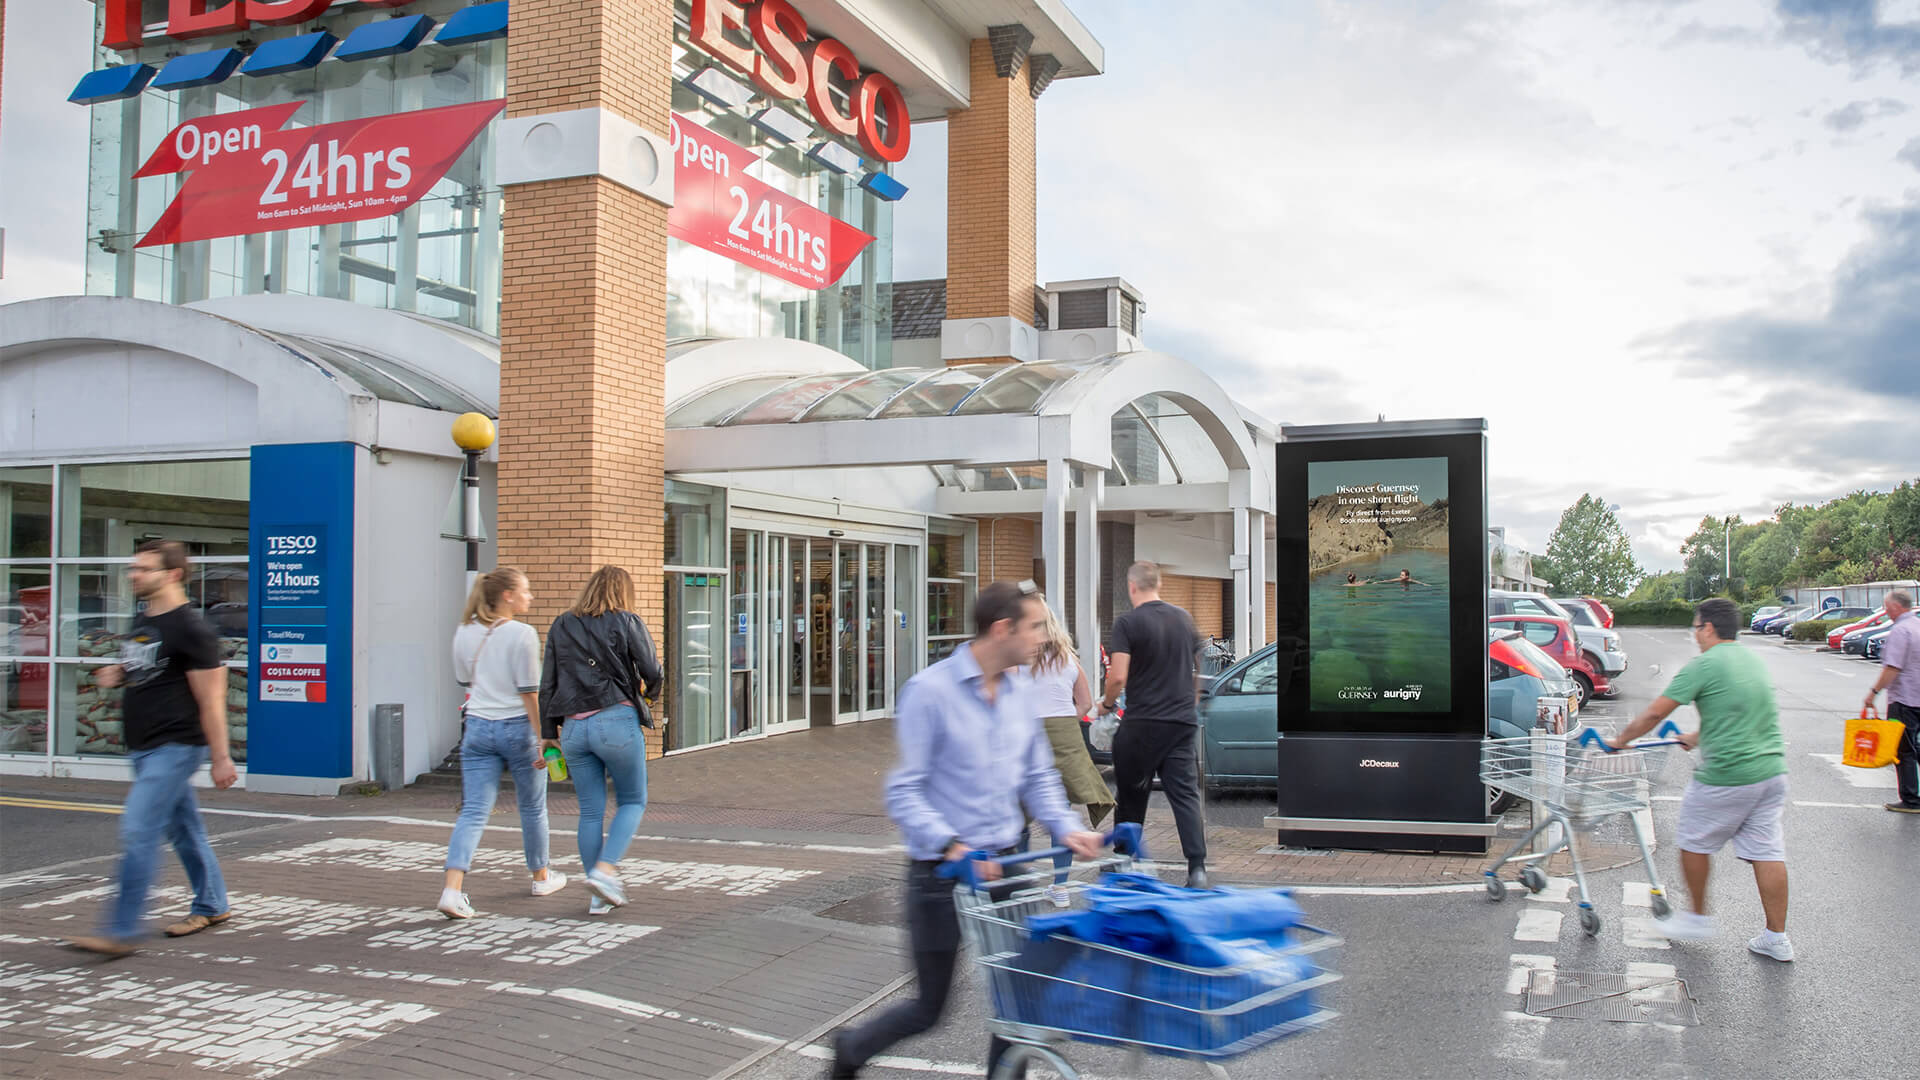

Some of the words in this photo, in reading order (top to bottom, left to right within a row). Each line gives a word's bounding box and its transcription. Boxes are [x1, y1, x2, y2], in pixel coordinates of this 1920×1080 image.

[688, 0, 911, 162] ESCO
[175, 124, 261, 165] Open
[259, 139, 412, 205] 24hrs
[257, 211, 273, 219] Mon
[273, 209, 290, 217] 6am
[299, 206, 312, 215] Sat
[312, 202, 347, 212] Midnight,
[348, 200, 363, 208] Sun
[364, 197, 385, 206] 10am
[390, 195, 407, 204] 4pm
[728, 186, 827, 271] 24hrs
[1336, 485, 1375, 494] Discover
[1376, 484, 1419, 494] Guernsey
[1338, 496, 1347, 505] in
[1367, 495, 1392, 504] short
[1394, 494, 1419, 505] flight
[267, 535, 317, 549] TESCO
[286, 563, 303, 571] open
[267, 571, 282, 586] 24
[284, 571, 320, 586] hours
[267, 668, 291, 677] COSTA
[292, 668, 321, 676] COFFEE
[1338, 690, 1378, 699] GUERNSEY
[1383, 688, 1421, 700] aurigny
[1359, 759, 1400, 768] JCDecaux
